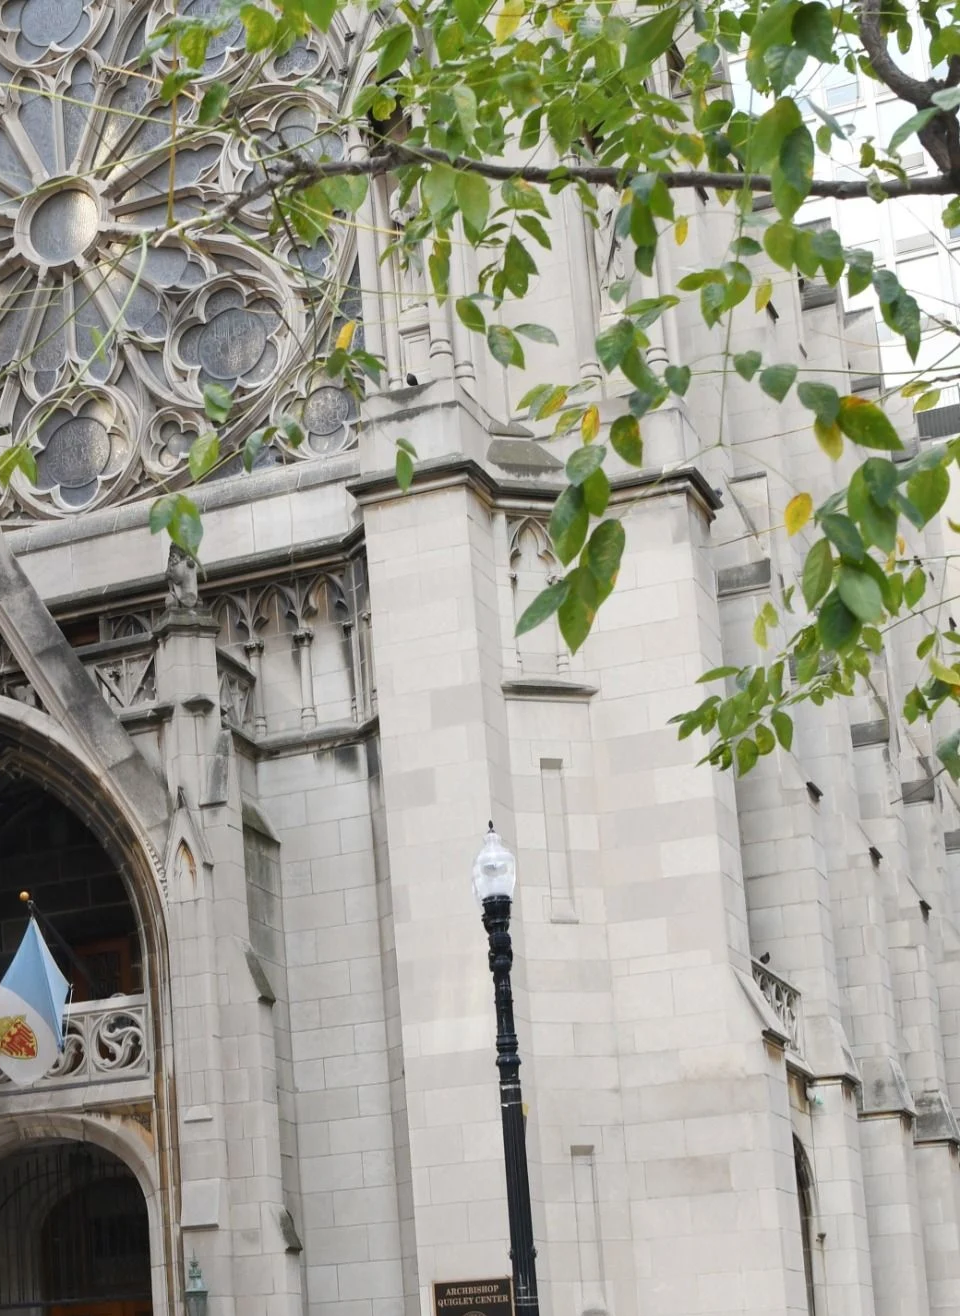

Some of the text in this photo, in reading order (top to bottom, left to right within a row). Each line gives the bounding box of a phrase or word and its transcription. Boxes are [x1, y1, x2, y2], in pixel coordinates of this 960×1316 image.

[445, 1285, 499, 1296] ARCHBISHOP
[437, 1294, 509, 1308] QUIGLEY CENTER
